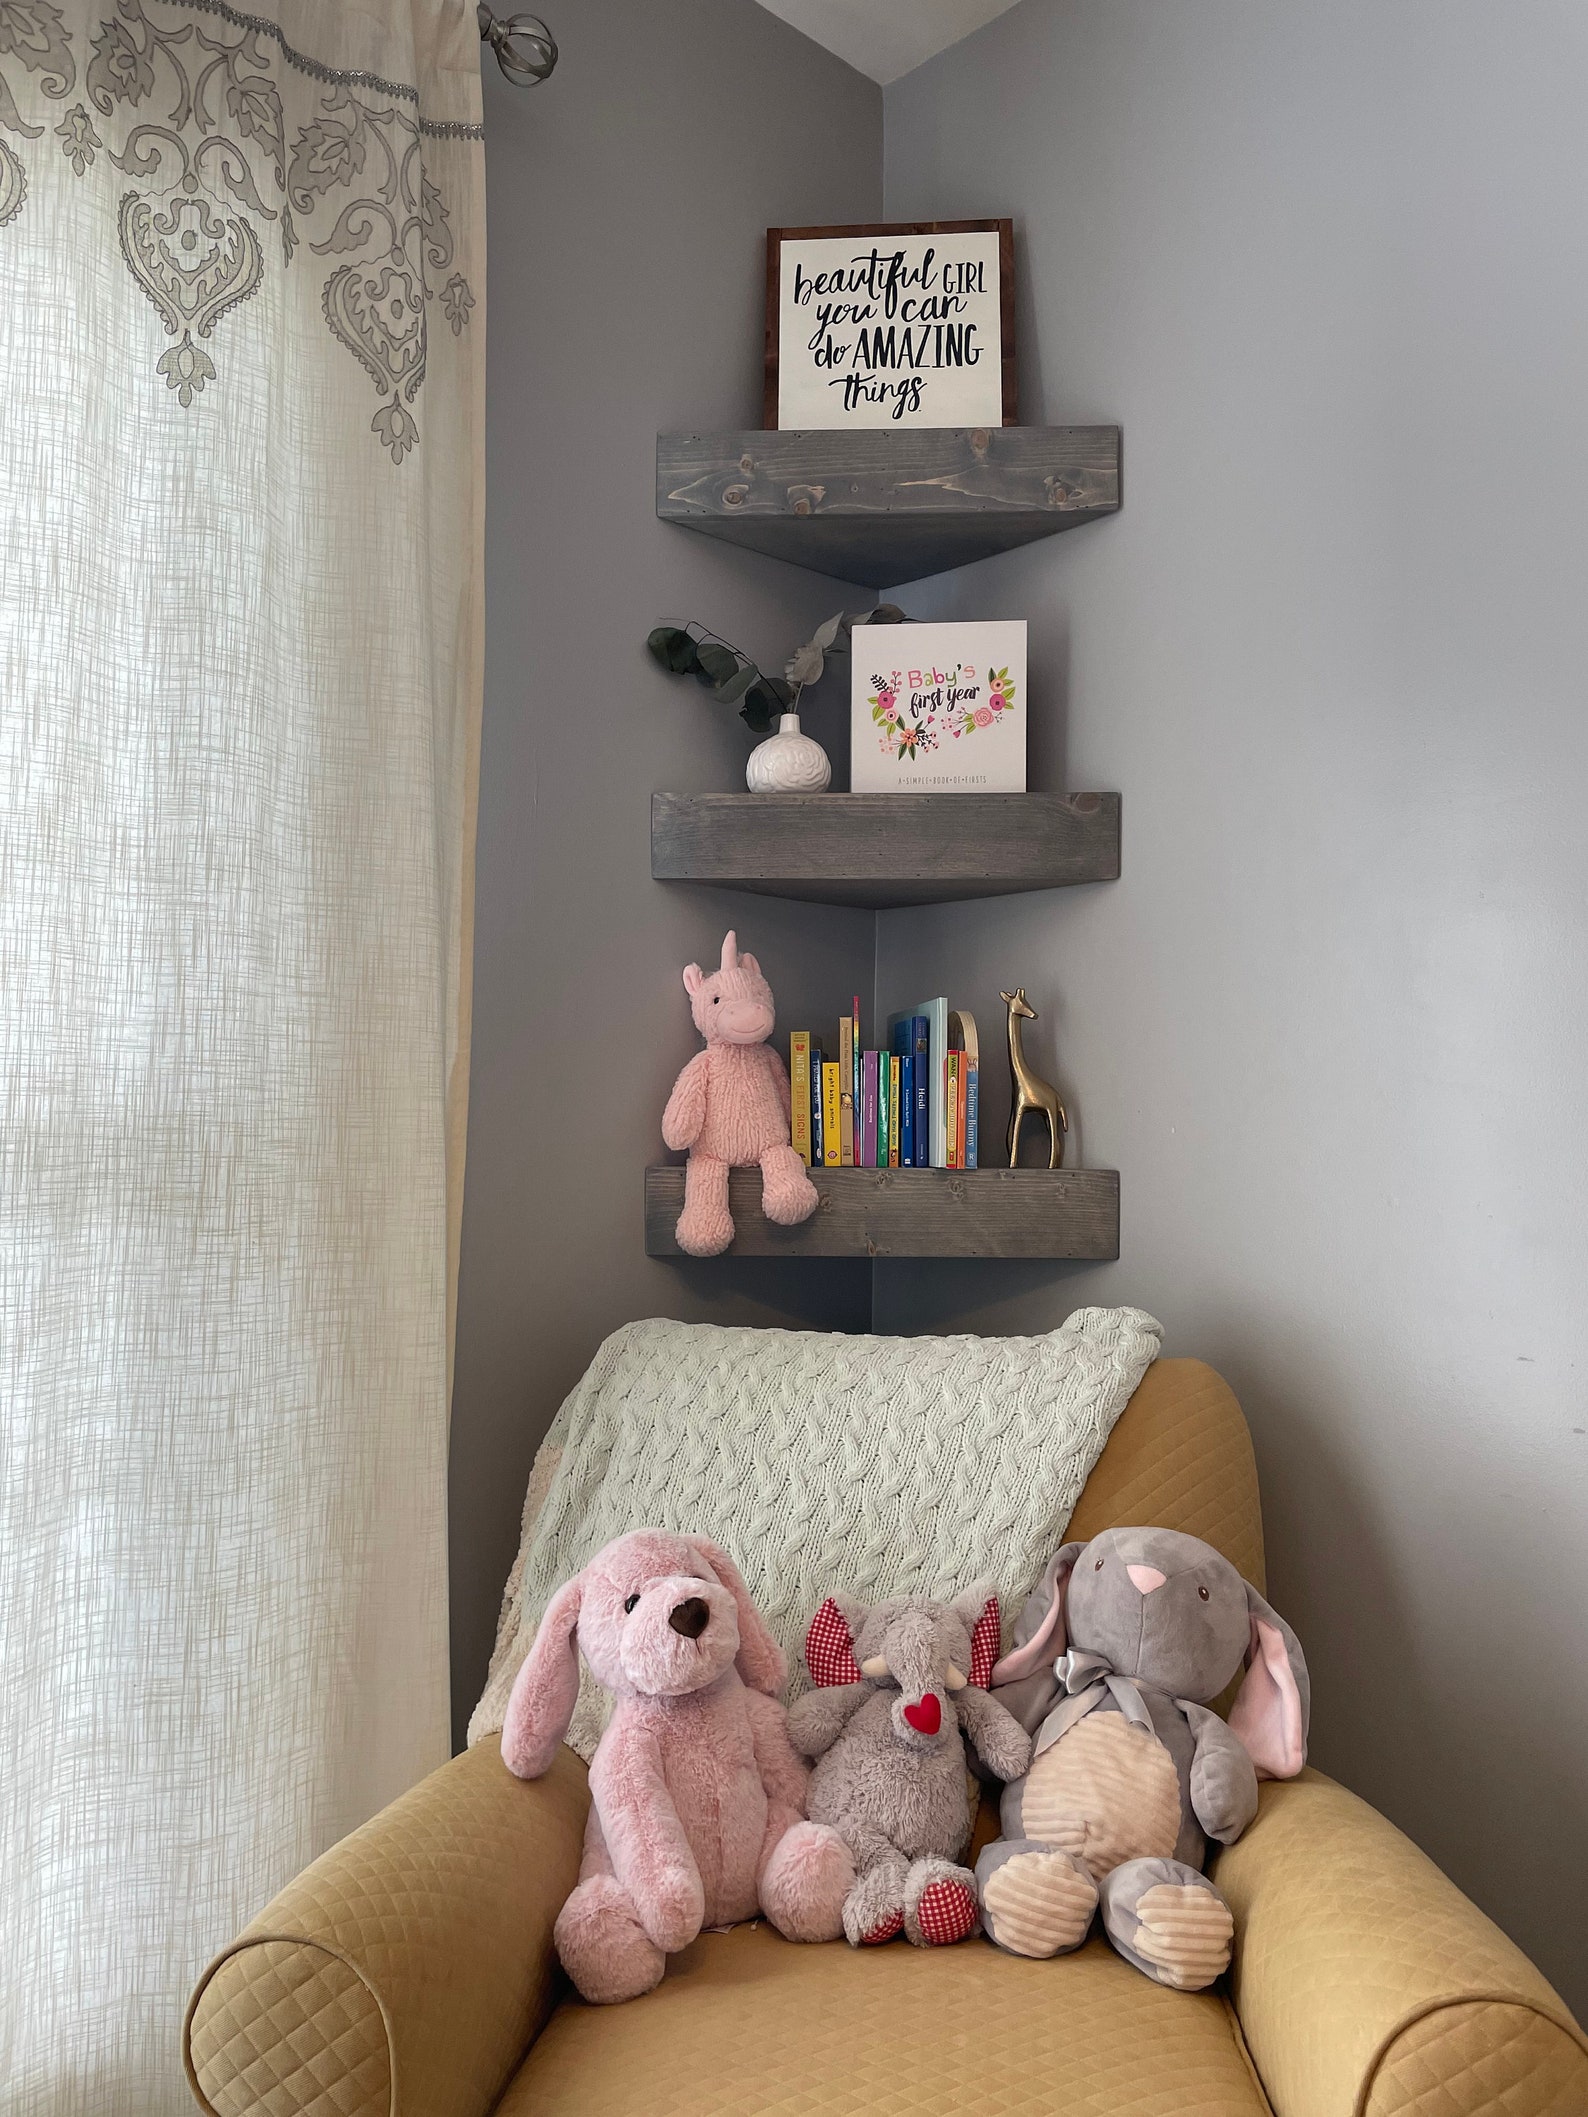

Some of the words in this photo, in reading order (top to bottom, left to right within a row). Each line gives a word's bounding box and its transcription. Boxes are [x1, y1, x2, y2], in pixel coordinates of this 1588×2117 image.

[793, 248, 939, 320] beautiful
[942, 261, 988, 294] GIRL
[807, 302, 878, 350] you
[900, 294, 968, 322] can
[814, 334, 852, 369] do
[852, 323, 984, 370] AMAZING
[908, 663, 976, 689] Baby's
[909, 687, 944, 719] first
[946, 686, 980, 712] year
[795, 1054, 805, 1082] NITA'S
[828, 1068, 836, 1088] bright
[796, 1085, 806, 1110] FIRST
[828, 1089, 836, 1104] baby
[918, 1088, 926, 1110] Heidi
[968, 1083, 977, 1118] Bedtime
[796, 1113, 806, 1140] SIGNS
[966, 1119, 976, 1147] Bunny
